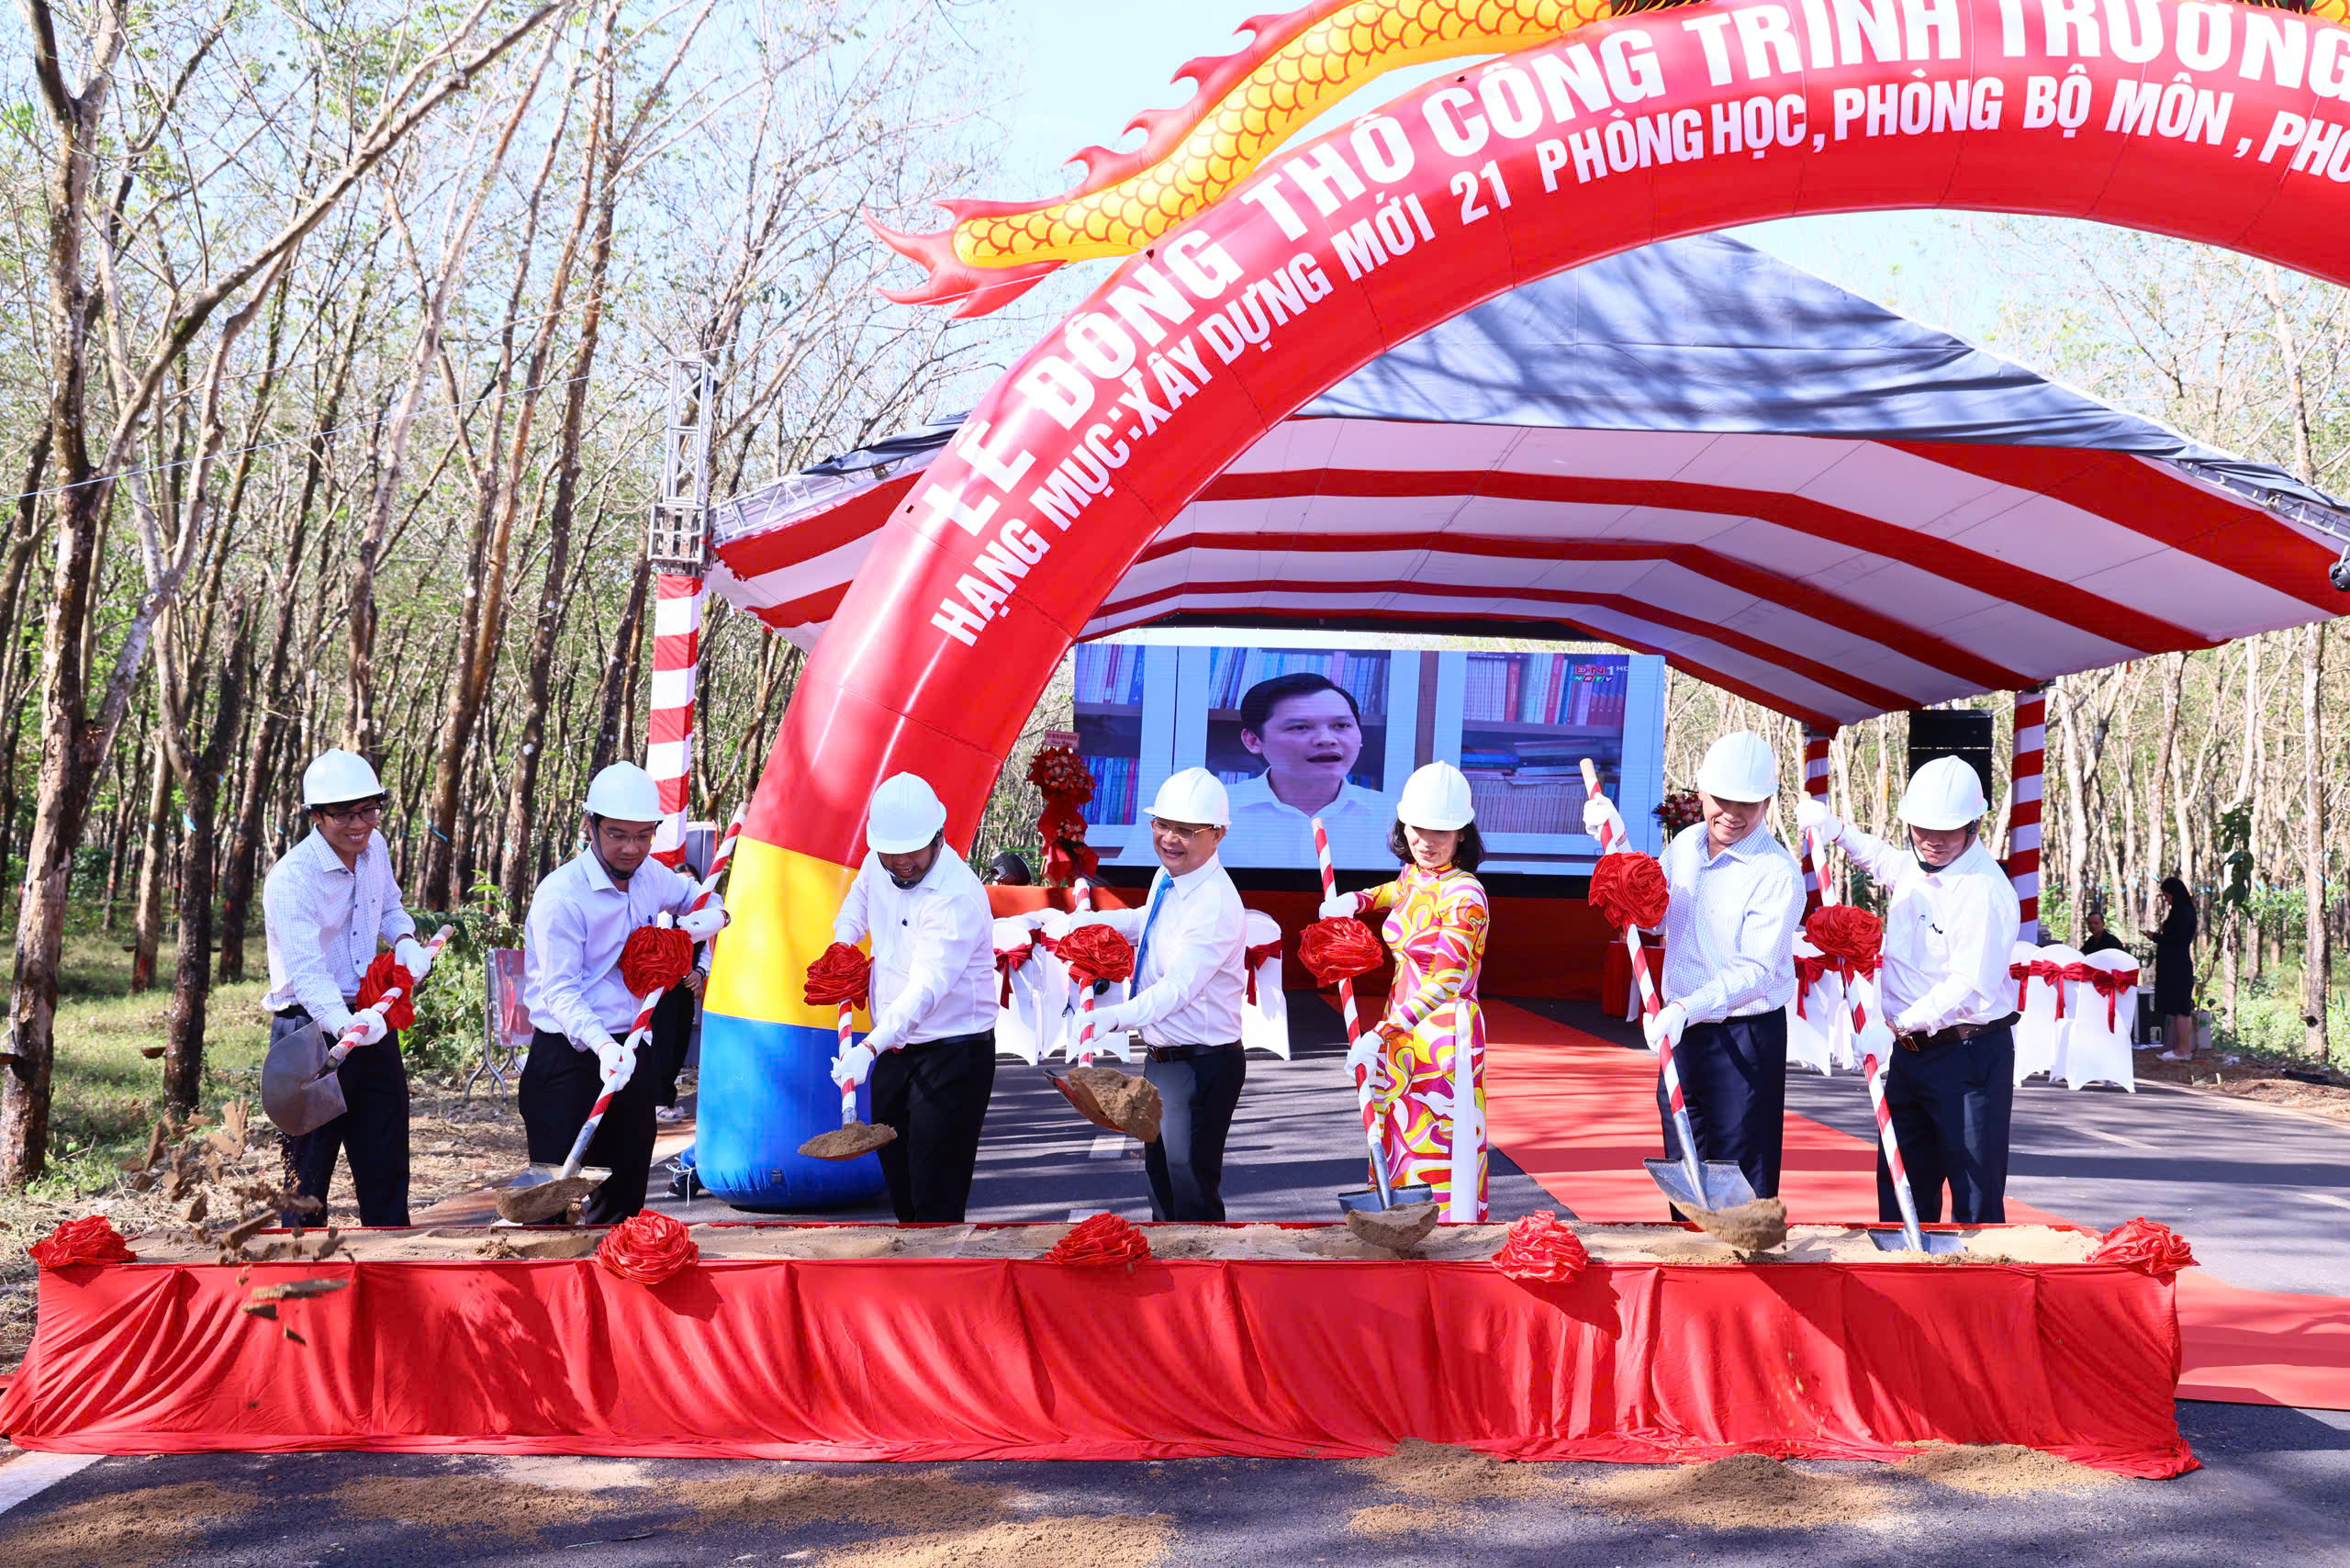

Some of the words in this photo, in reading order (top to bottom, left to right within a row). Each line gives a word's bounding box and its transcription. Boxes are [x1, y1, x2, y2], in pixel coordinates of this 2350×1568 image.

[1422, 29, 1666, 158] CÔNG
[930, 519, 1050, 646] HẠNG
[1197, 252, 1334, 365] DỰNG
[1330, 191, 1436, 280] MỚI
[1450, 160, 1512, 226] 21
[1536, 109, 1704, 193] PHÒNG
[1833, 68, 2004, 140] PHÒNG
[2022, 63, 2092, 139] BỘ
